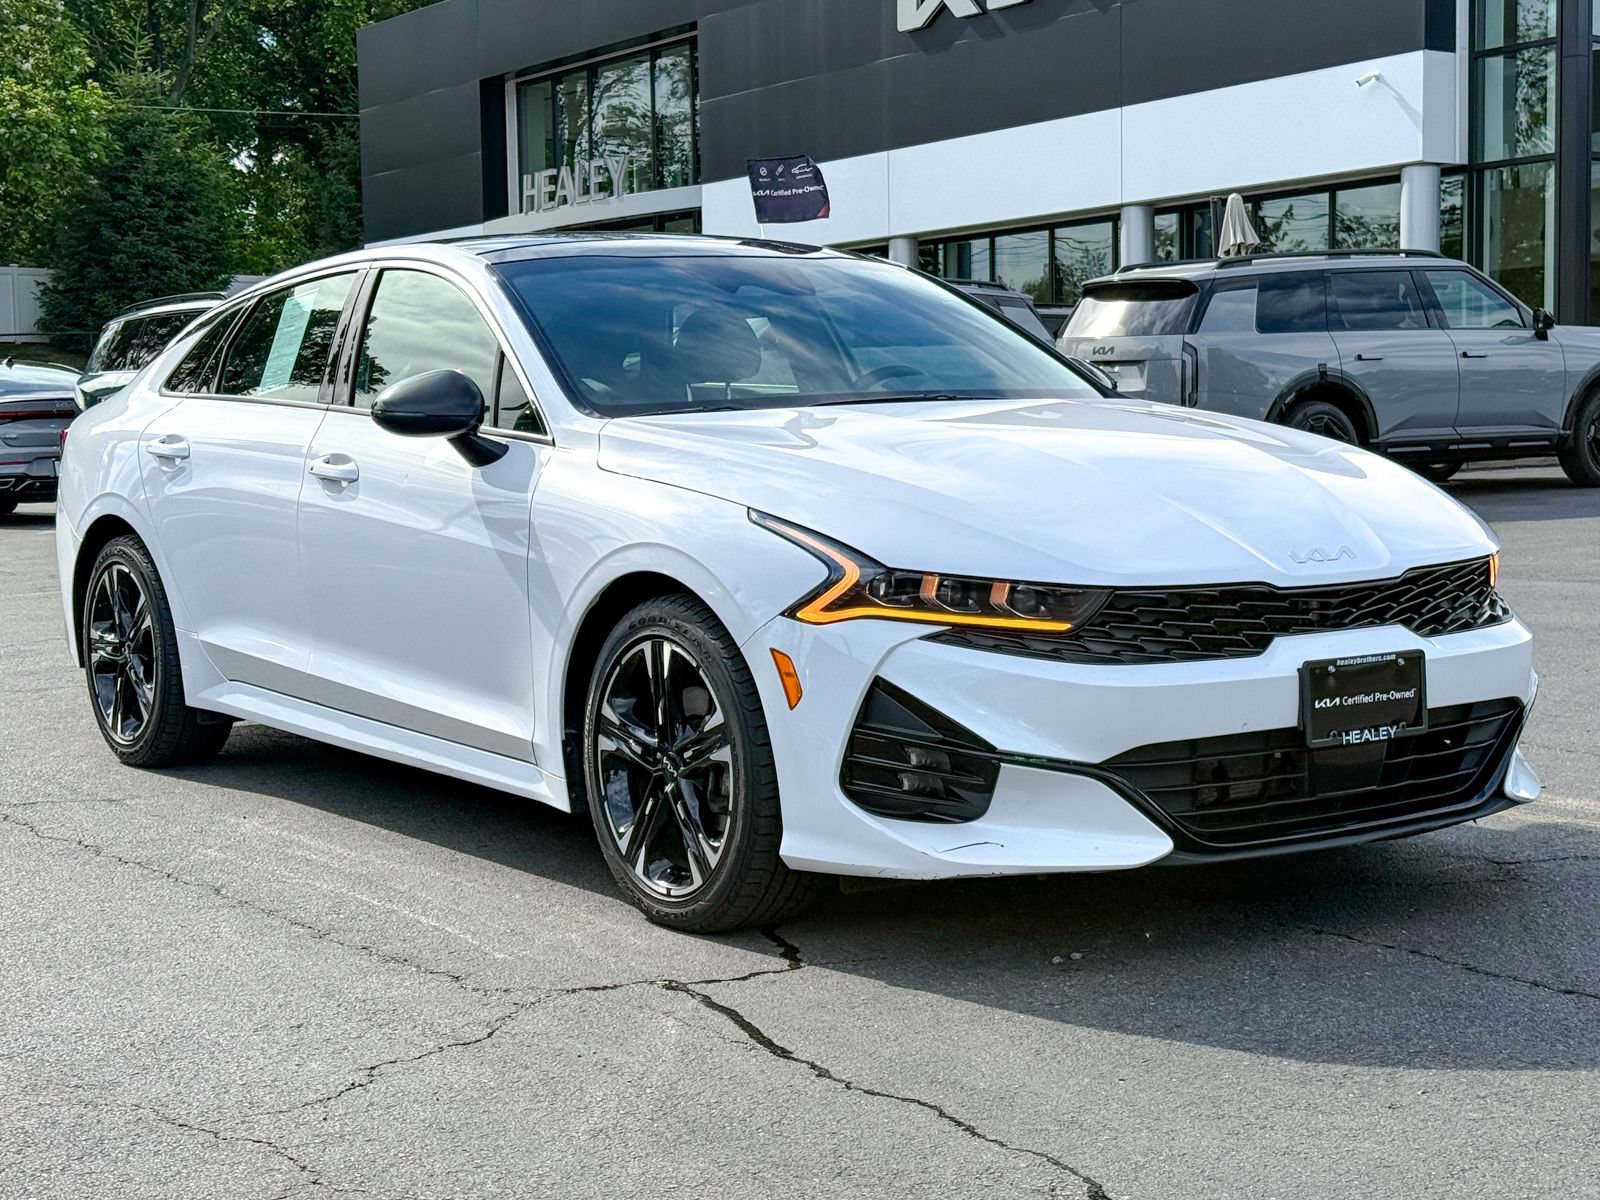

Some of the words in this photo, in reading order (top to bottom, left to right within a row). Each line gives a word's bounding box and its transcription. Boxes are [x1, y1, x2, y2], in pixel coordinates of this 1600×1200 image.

[522, 153, 629, 214] HEALEY
[771, 188, 791, 196] Certified
[1092, 346, 1115, 355] KIA
[1287, 545, 1357, 564] KIA
[1336, 654, 1397, 666] healeybrothers.com
[1315, 697, 1340, 709] KIA
[1342, 692, 1374, 706] Certified
[1375, 689, 1415, 703] Pre-Owned
[1342, 725, 1397, 745] HEALEY
